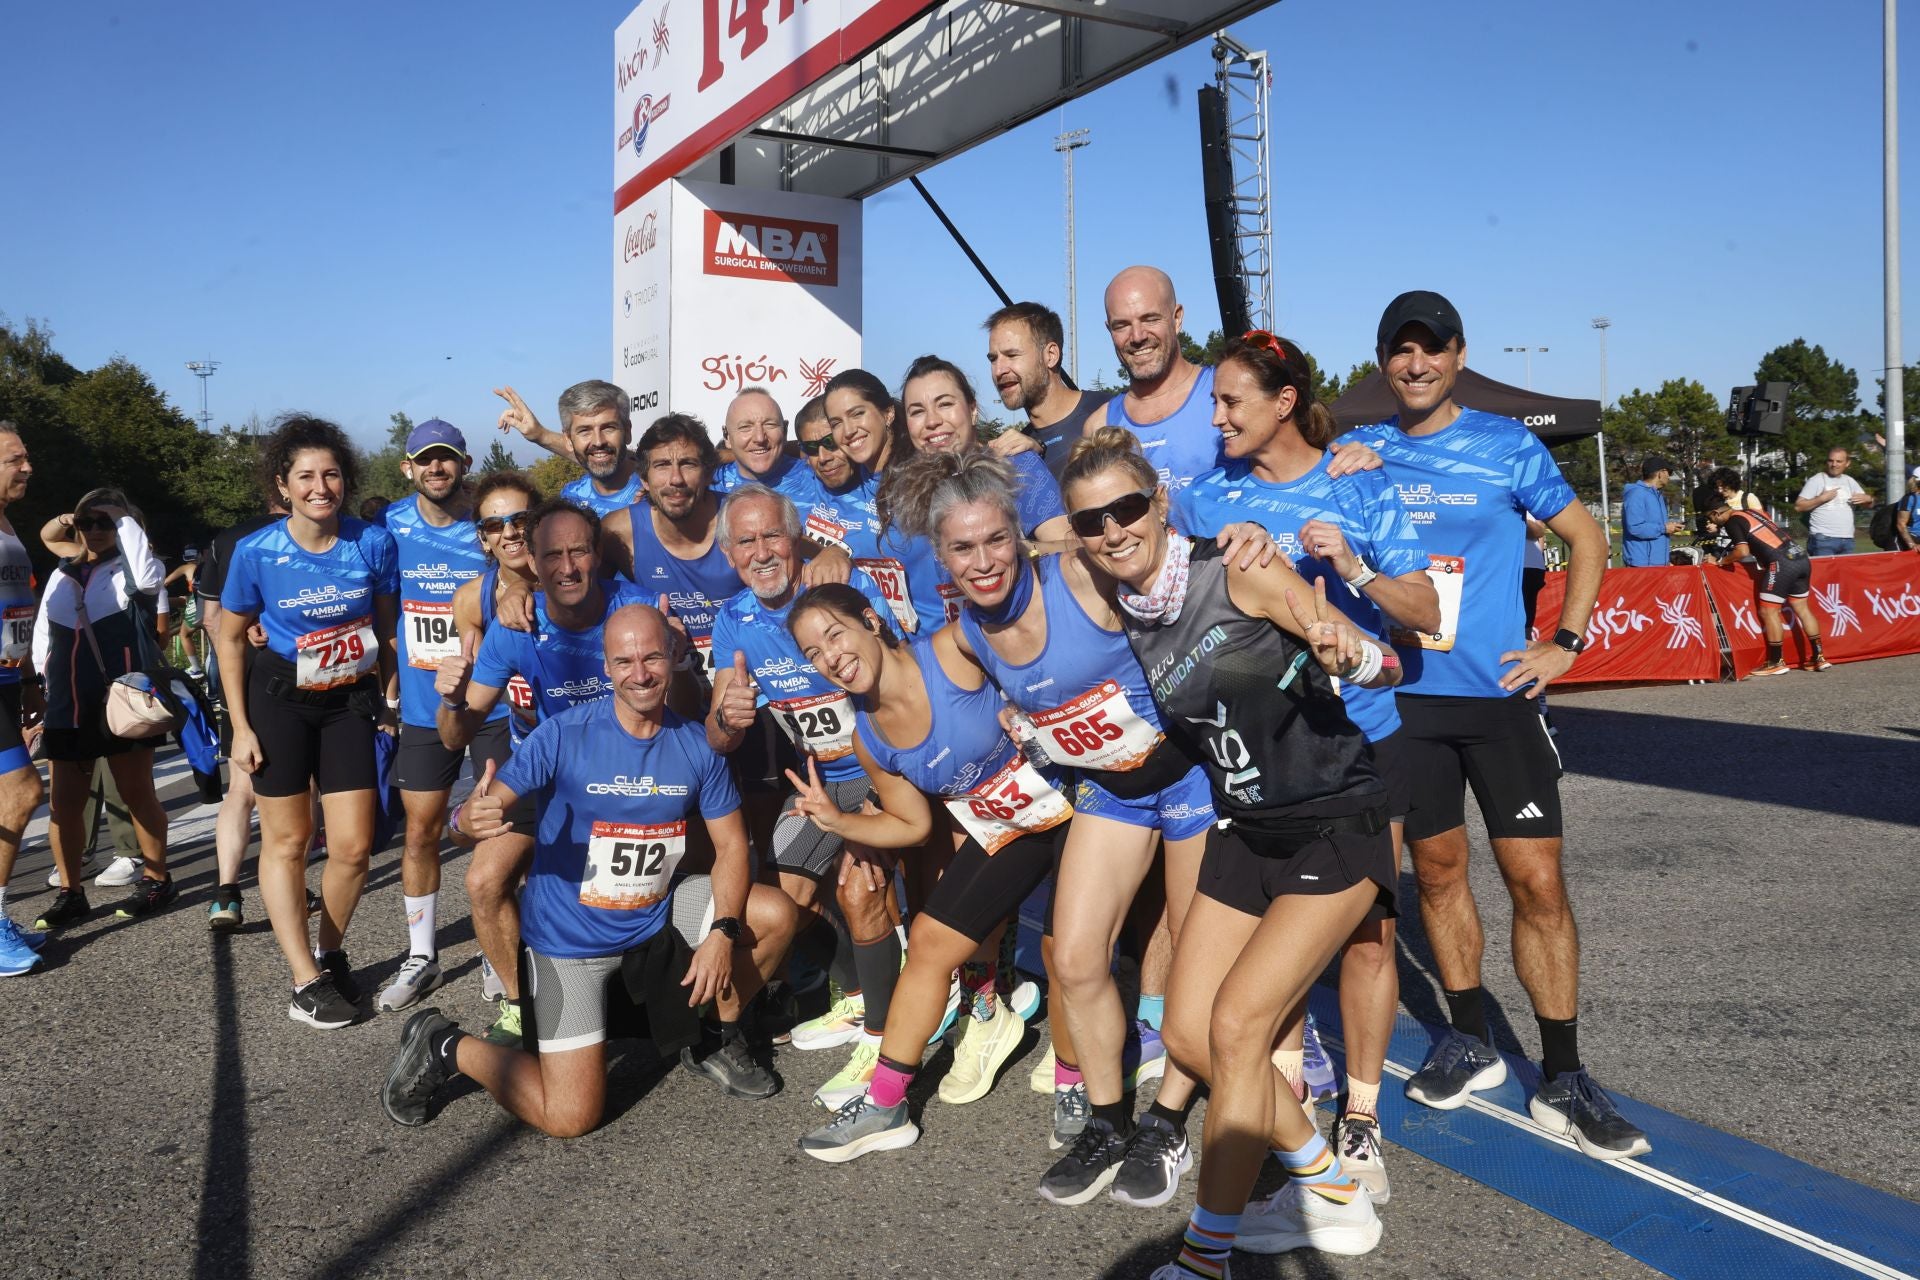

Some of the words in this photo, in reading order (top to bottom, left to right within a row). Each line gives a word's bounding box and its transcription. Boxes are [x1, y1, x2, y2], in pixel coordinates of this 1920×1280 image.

[715, 256, 758, 269] SURGICAL
[760, 260, 827, 276] EMPOWERMENT
[417, 563, 448, 571] CLUB
[299, 585, 336, 599] CLUB
[425, 582, 457, 590] AMBAR
[311, 604, 348, 617] AMBAR
[316, 635, 364, 669] 729
[1154, 625, 1228, 704] OUNDATION
[563, 676, 598, 689] CLUB
[1051, 709, 1124, 757] 665
[614, 775, 654, 786] CLUB
[968, 780, 1034, 820] 663
[611, 842, 667, 877] 512
